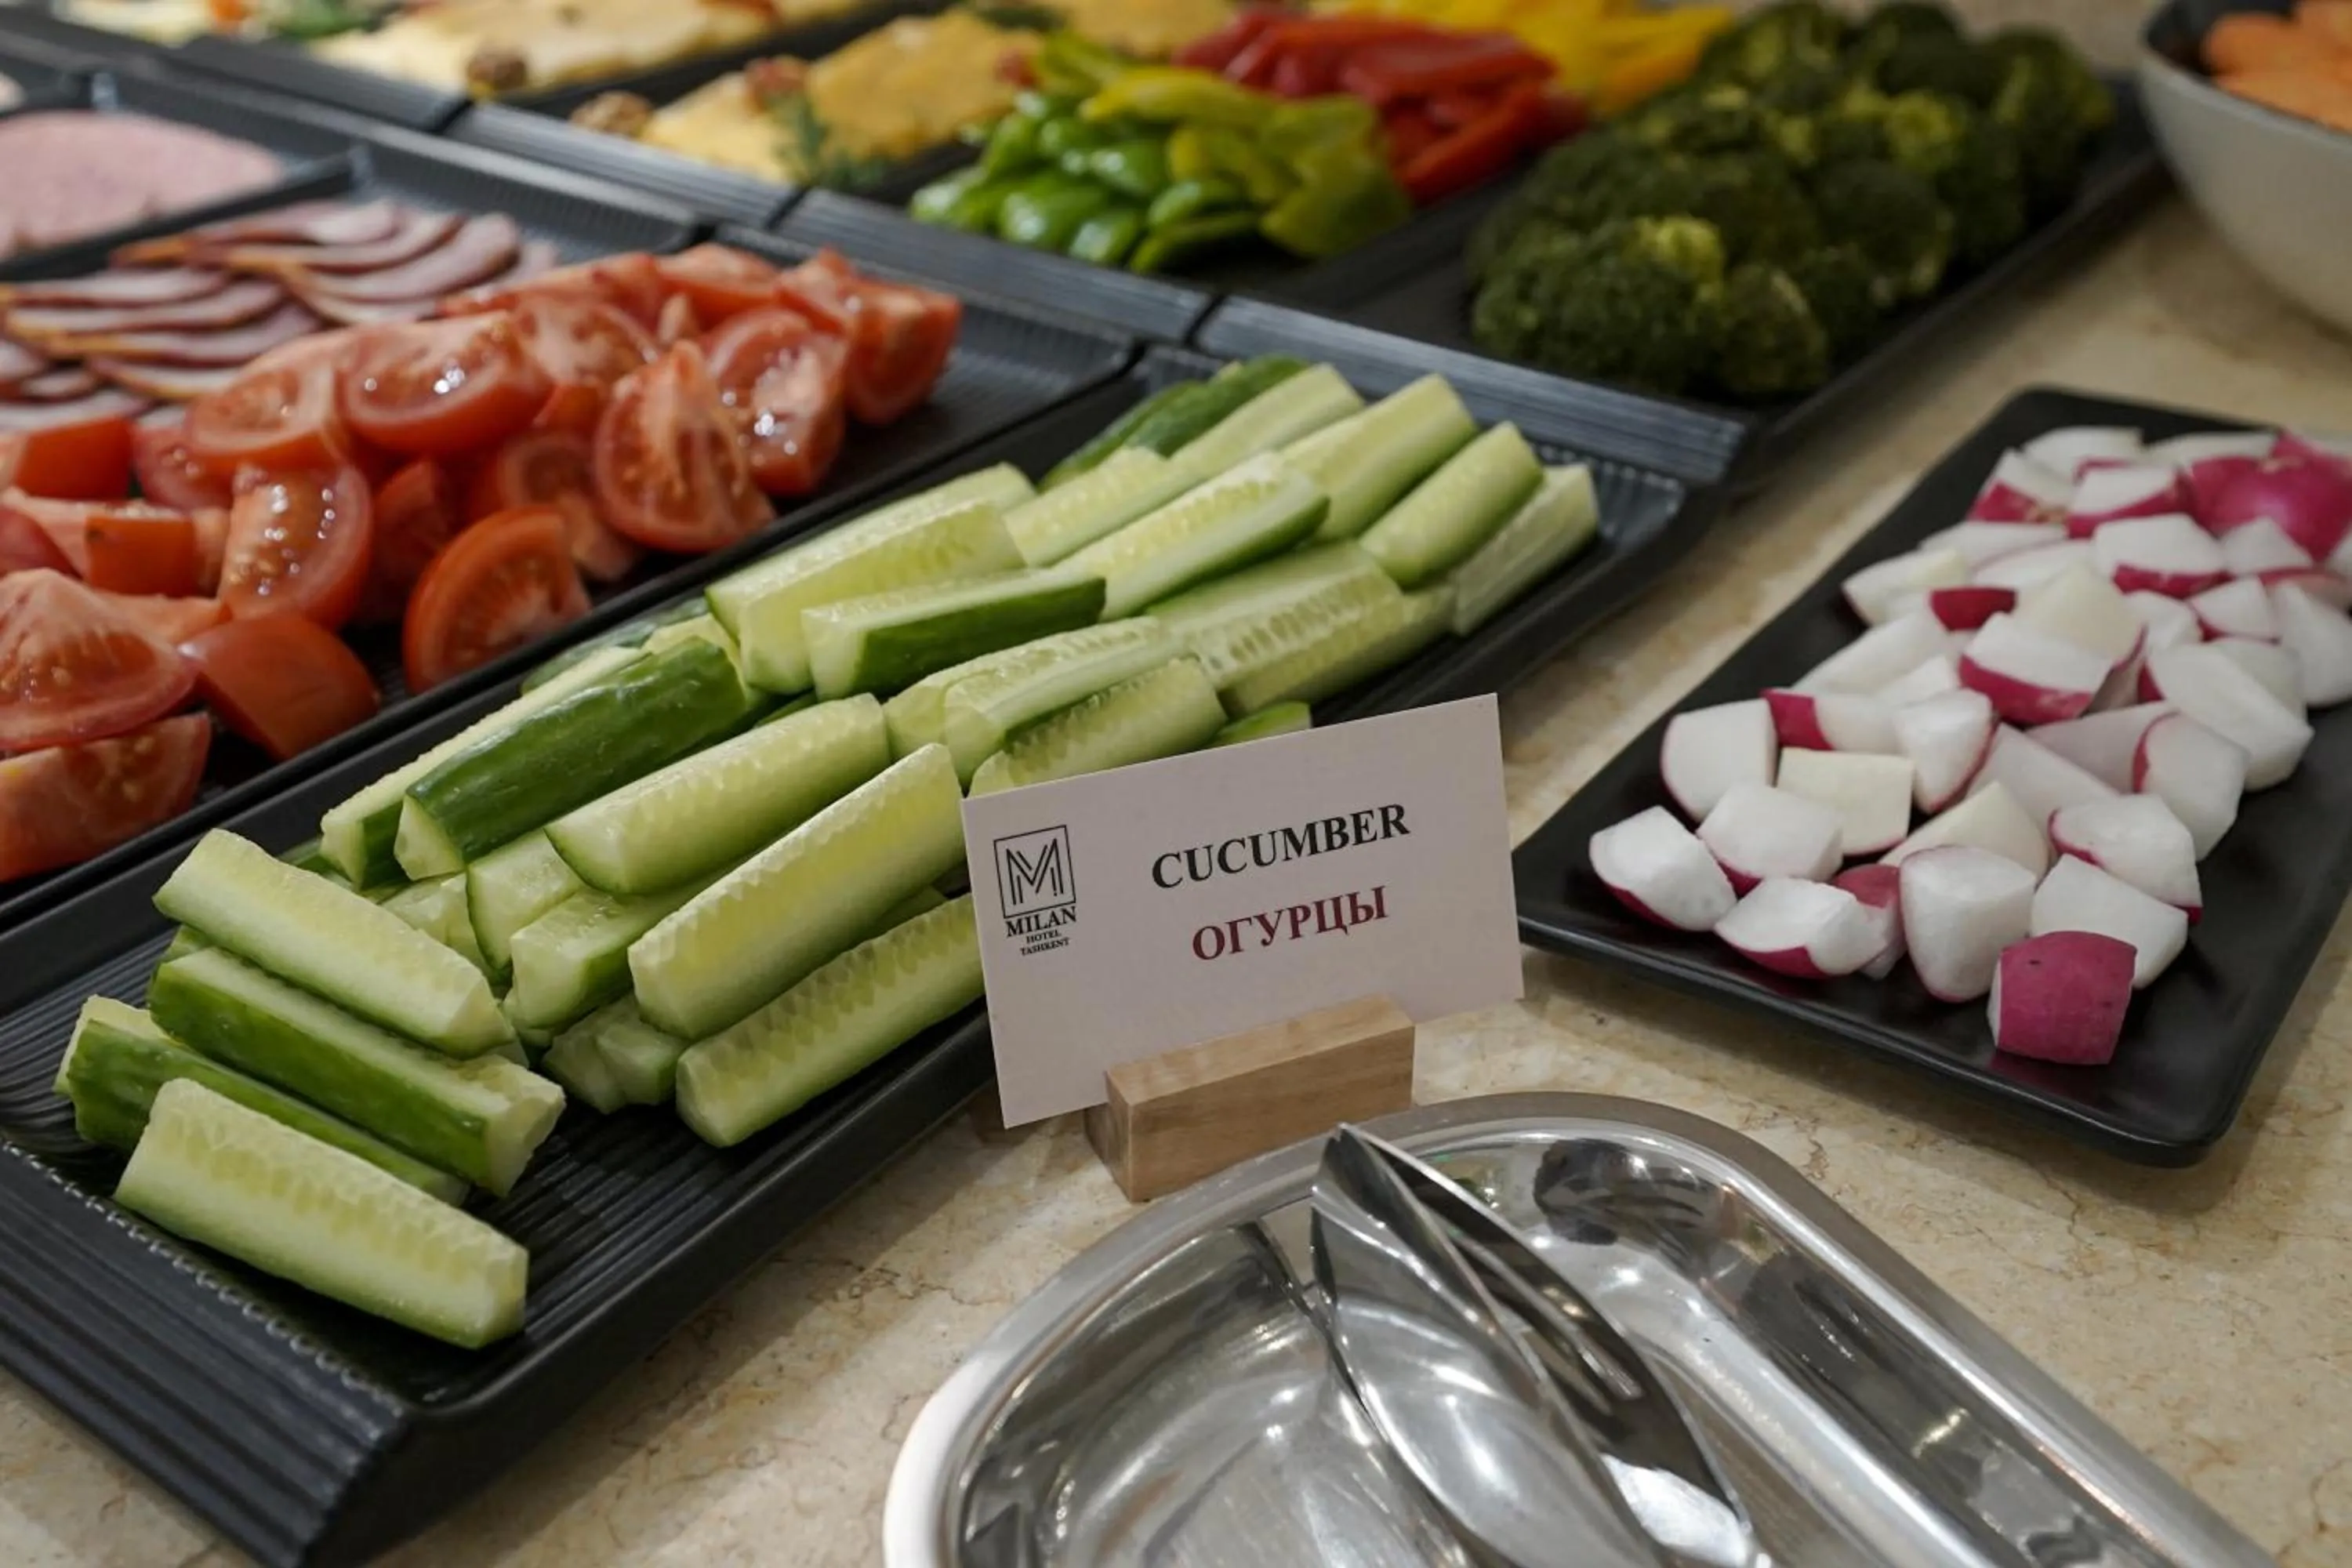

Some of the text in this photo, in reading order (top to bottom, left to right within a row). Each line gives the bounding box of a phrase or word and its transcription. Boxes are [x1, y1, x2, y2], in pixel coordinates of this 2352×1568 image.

[1152, 803, 1410, 889] CUCUMBER
[1005, 906, 1077, 938] MILAN
[1025, 929, 1062, 944] HOTEL
[1192, 885, 1389, 960] ОГУРЦЫ
[1020, 937, 1069, 956] TASHKENT
